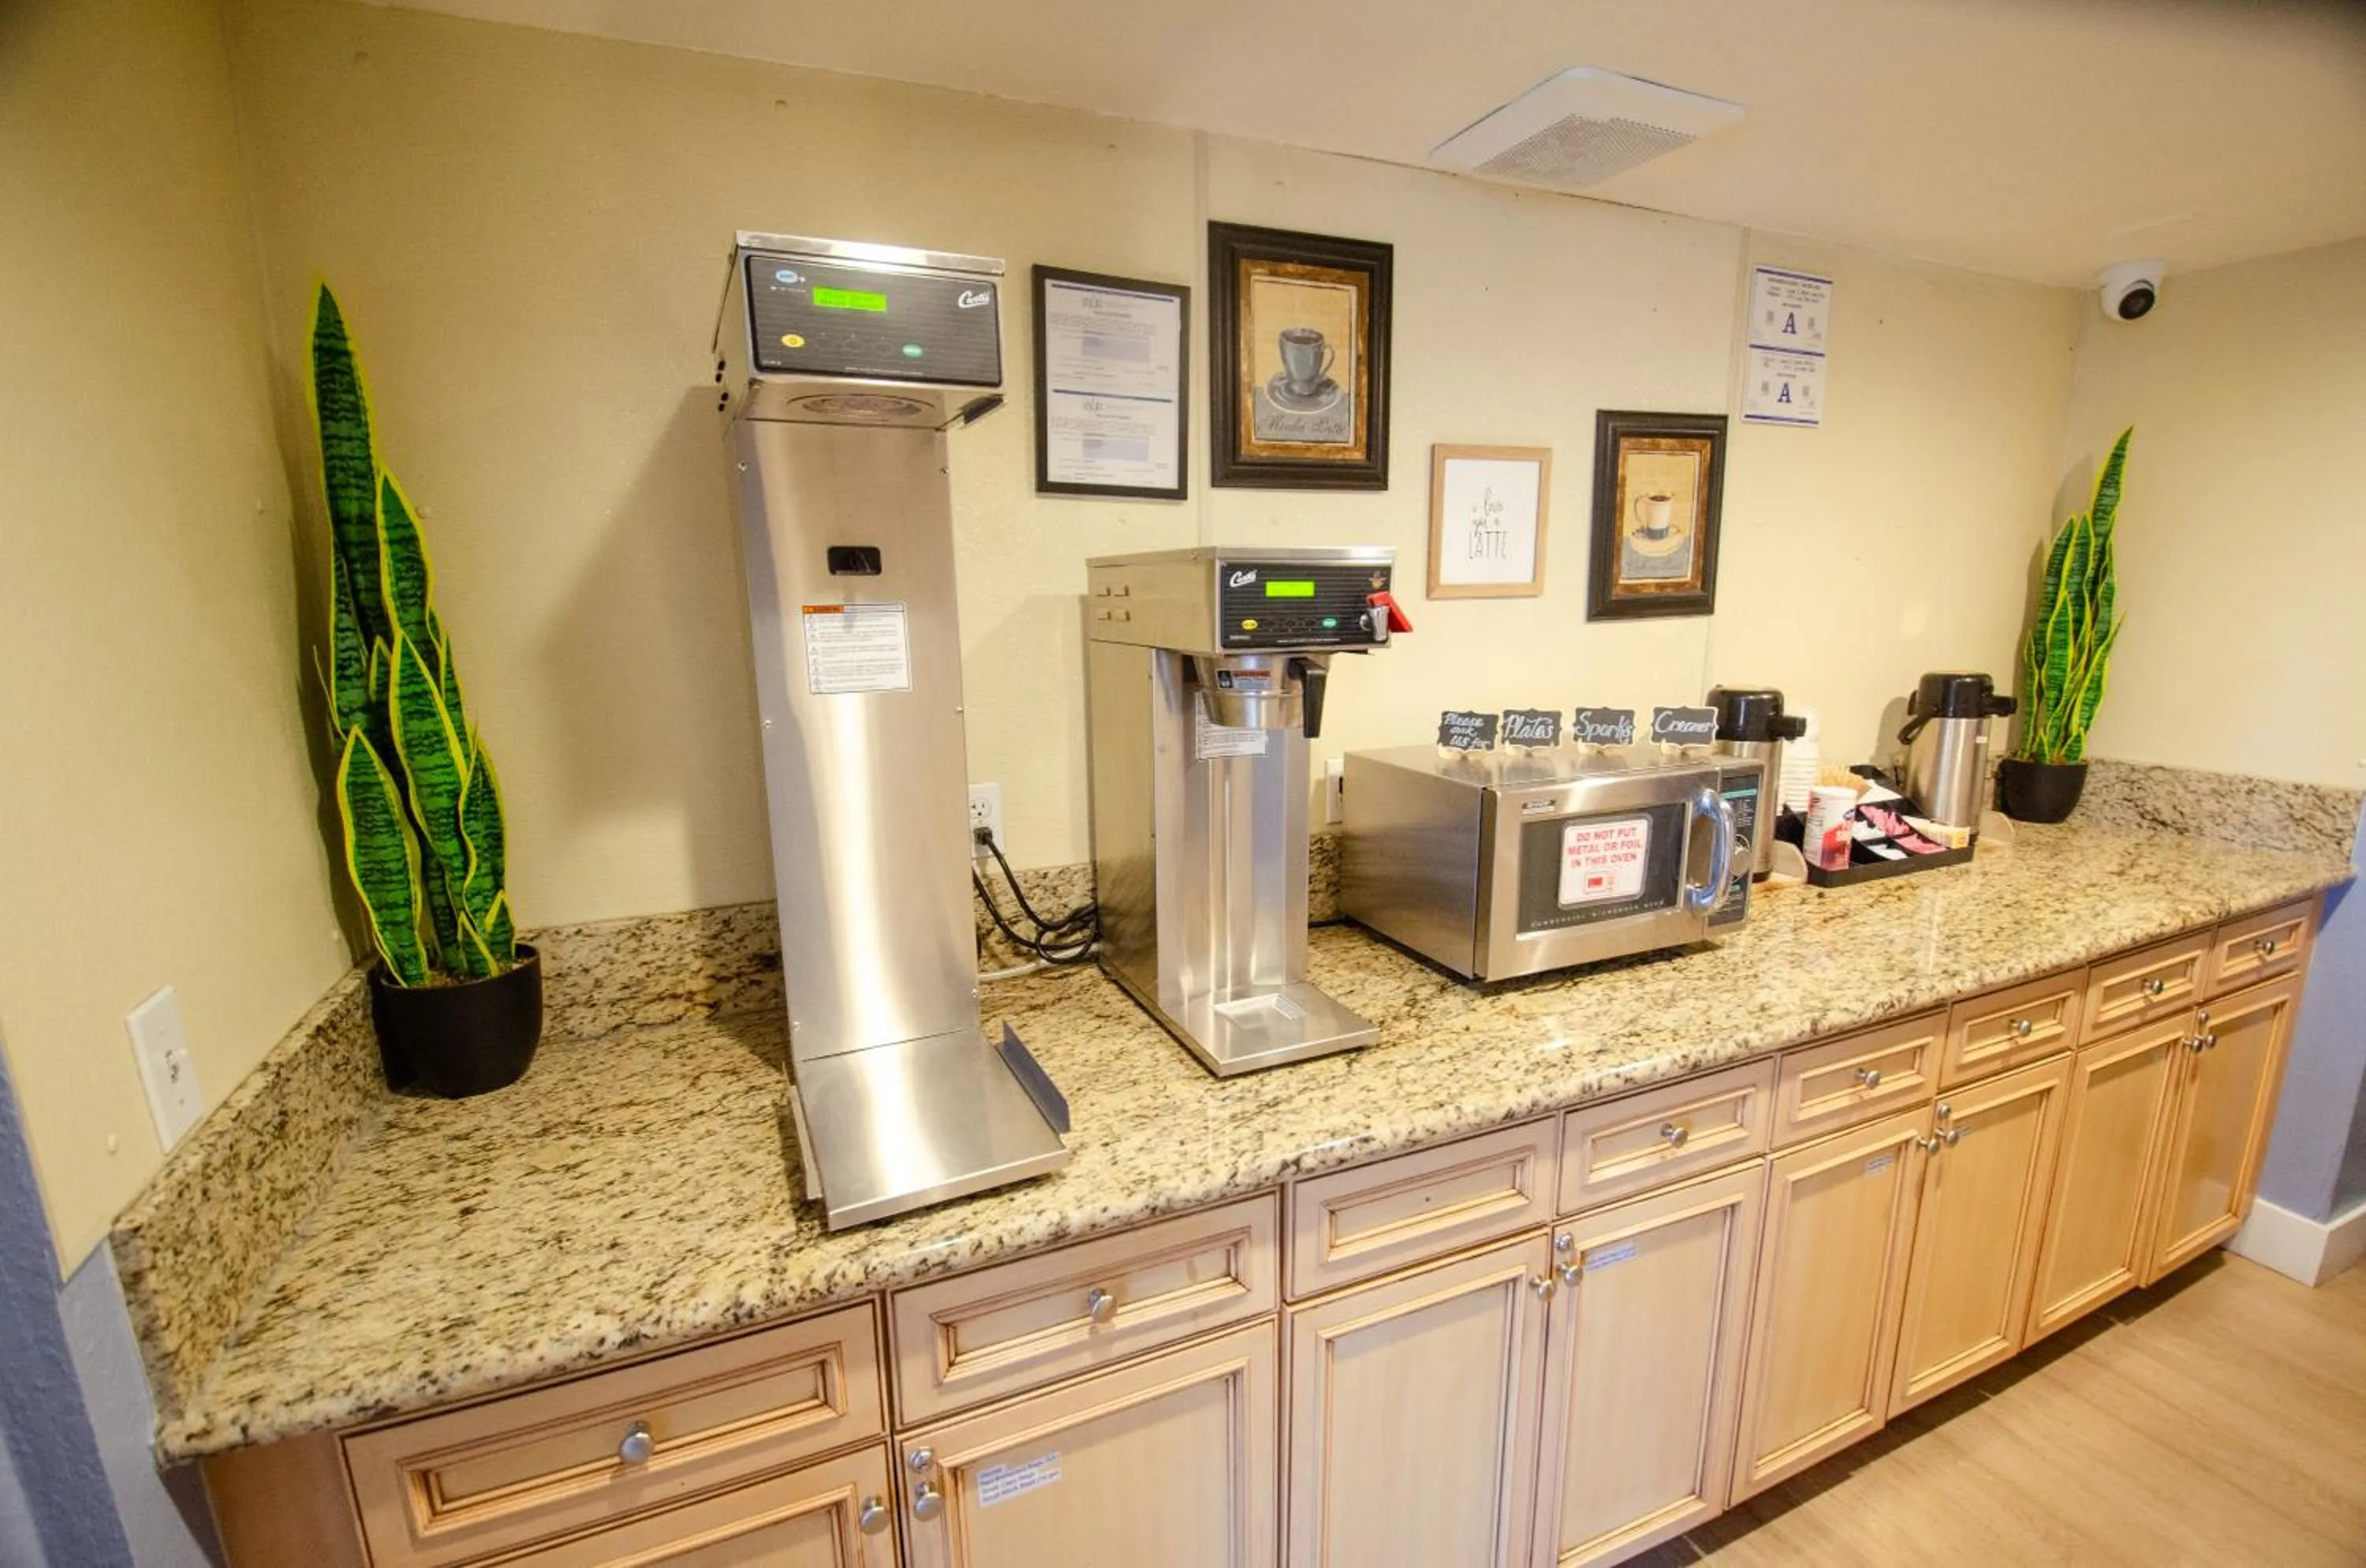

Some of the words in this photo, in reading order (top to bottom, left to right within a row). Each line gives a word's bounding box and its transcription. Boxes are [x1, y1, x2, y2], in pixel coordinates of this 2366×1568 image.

[1782, 311, 1797, 334] A
[1777, 381, 1792, 404] A
[1468, 531, 1510, 560] LATTE
[1443, 713, 1484, 727] Please
[1504, 713, 1554, 739] Plates
[1577, 832, 1591, 842] DO
[1594, 829, 1614, 840] NOT
[1617, 827, 1637, 838] PUT
[1567, 843, 1599, 856] METAL
[1603, 841, 1618, 851] OR
[1621, 838, 1642, 849] FOIL
[1571, 858, 1580, 868] IN
[1585, 855, 1607, 866] THIS
[1610, 852, 1636, 864] OVEN
